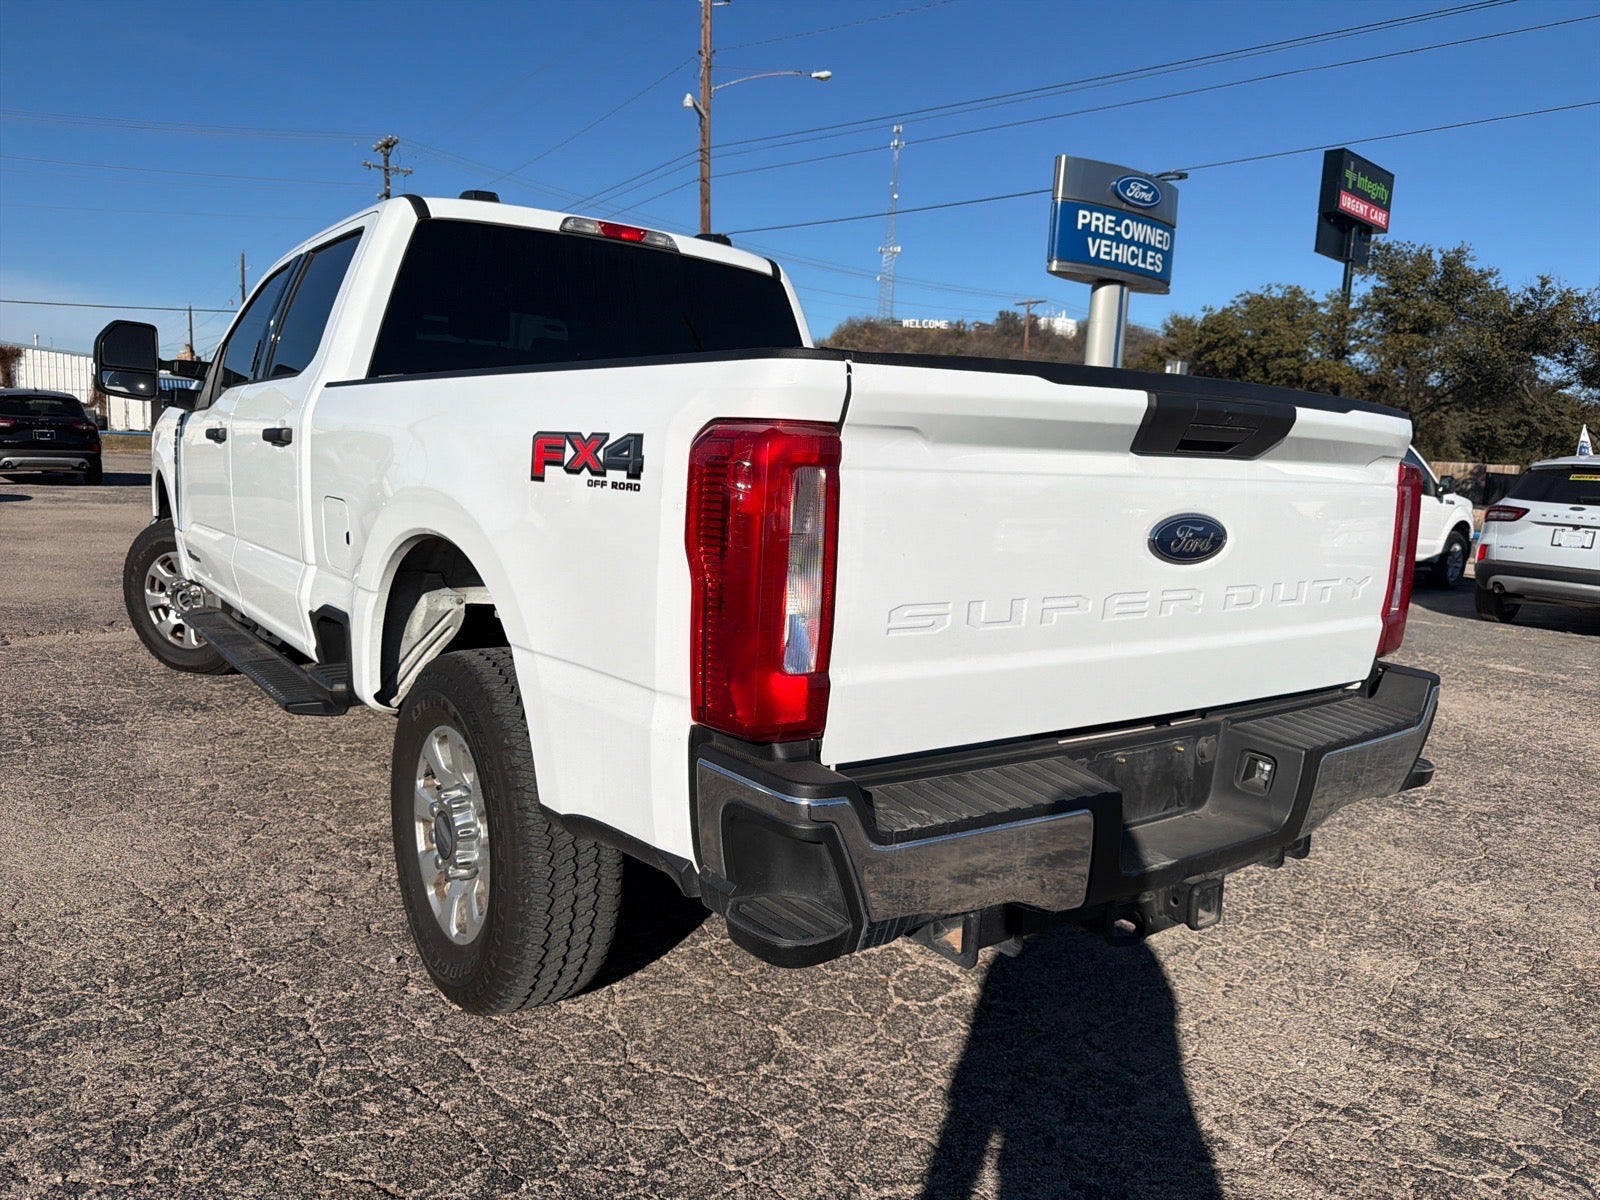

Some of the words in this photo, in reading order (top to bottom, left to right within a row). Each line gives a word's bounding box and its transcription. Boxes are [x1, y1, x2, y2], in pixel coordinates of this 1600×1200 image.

[1126, 181, 1155, 202] Ford
[1357, 171, 1390, 205] Integrity
[1341, 194, 1369, 217] URGENT
[1370, 208, 1387, 226] CARE
[1077, 209, 1170, 251] PRE-OWNED
[1087, 237, 1163, 273] VEHICLES
[902, 318, 949, 330] WELCOME
[530, 431, 645, 482] FX4
[587, 479, 608, 489] OFF
[610, 481, 641, 492] ROAD
[1170, 524, 1215, 553] Ford
[886, 587, 1204, 636] SUPER
[1222, 575, 1373, 613] DUTY
